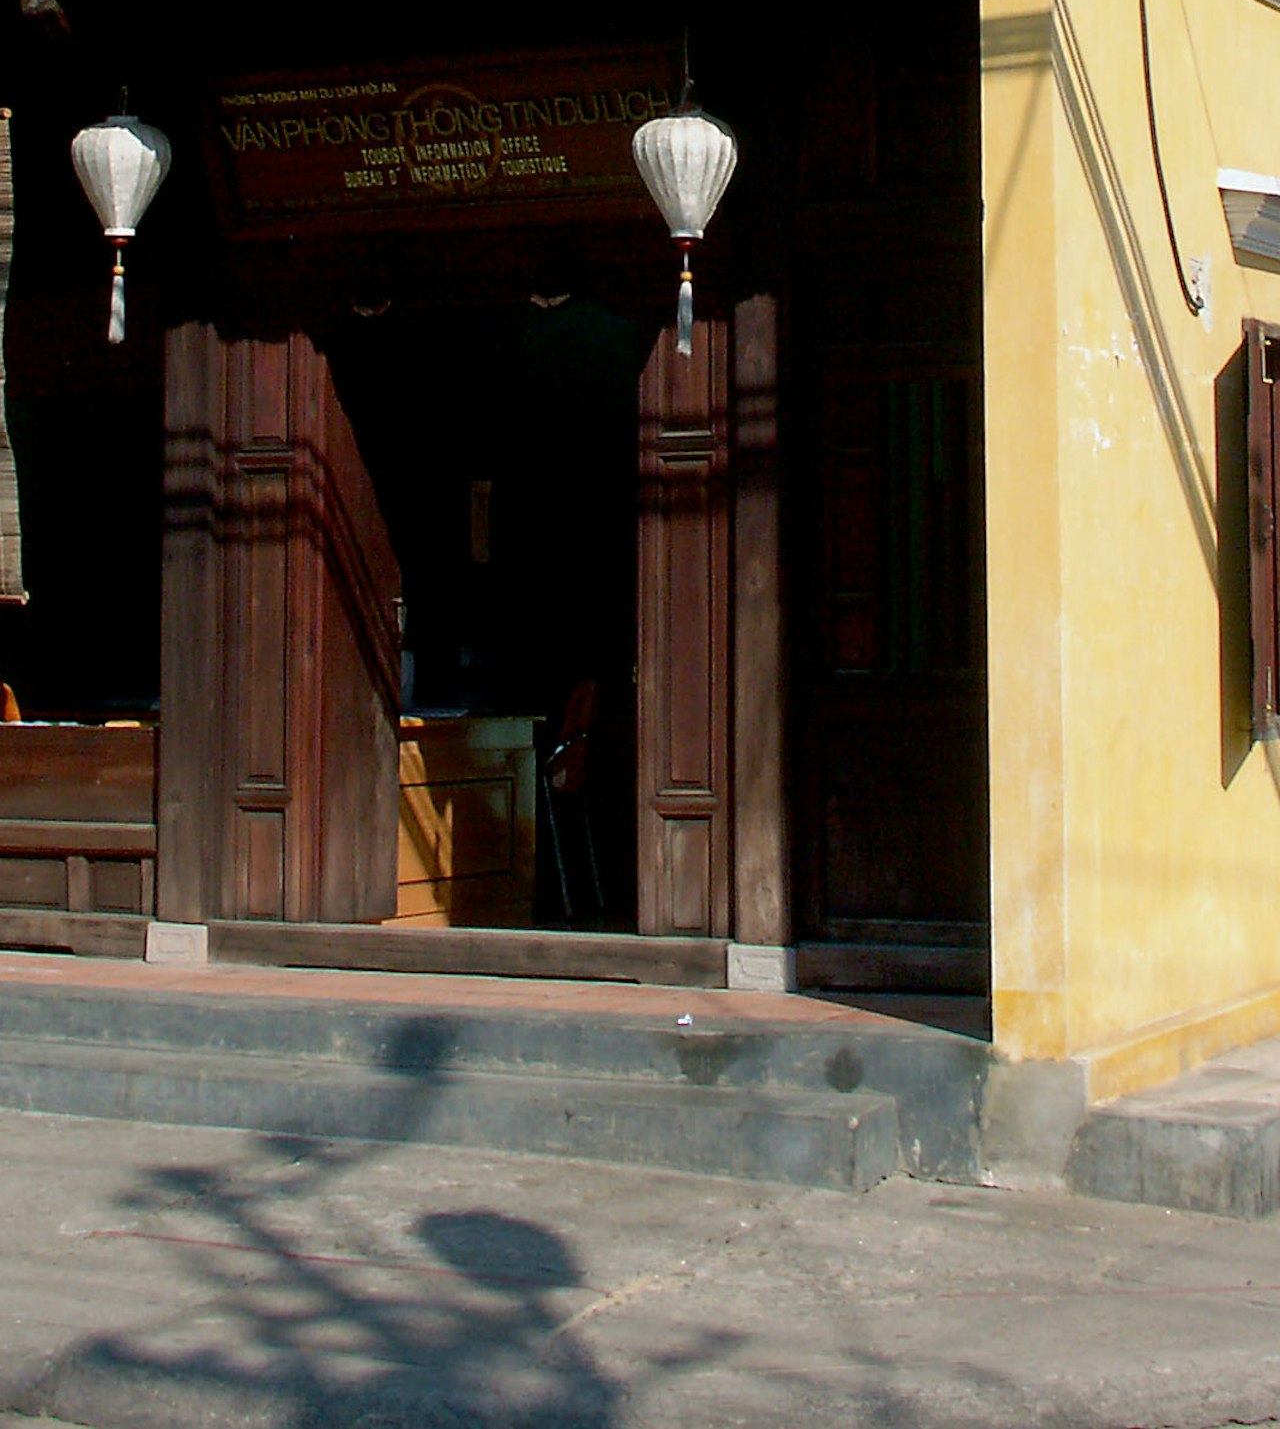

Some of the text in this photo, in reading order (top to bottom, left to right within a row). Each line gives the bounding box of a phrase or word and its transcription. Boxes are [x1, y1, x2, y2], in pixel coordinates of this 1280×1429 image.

[503, 98, 552, 130] TIN
[553, 96, 600, 126] DU
[360, 136, 541, 167] TOURIST INFORMATION OFFICE
[342, 171, 382, 189] BUREAU
[408, 163, 487, 184] INFORMATION
[499, 155, 569, 177] TOURISTIQUE
